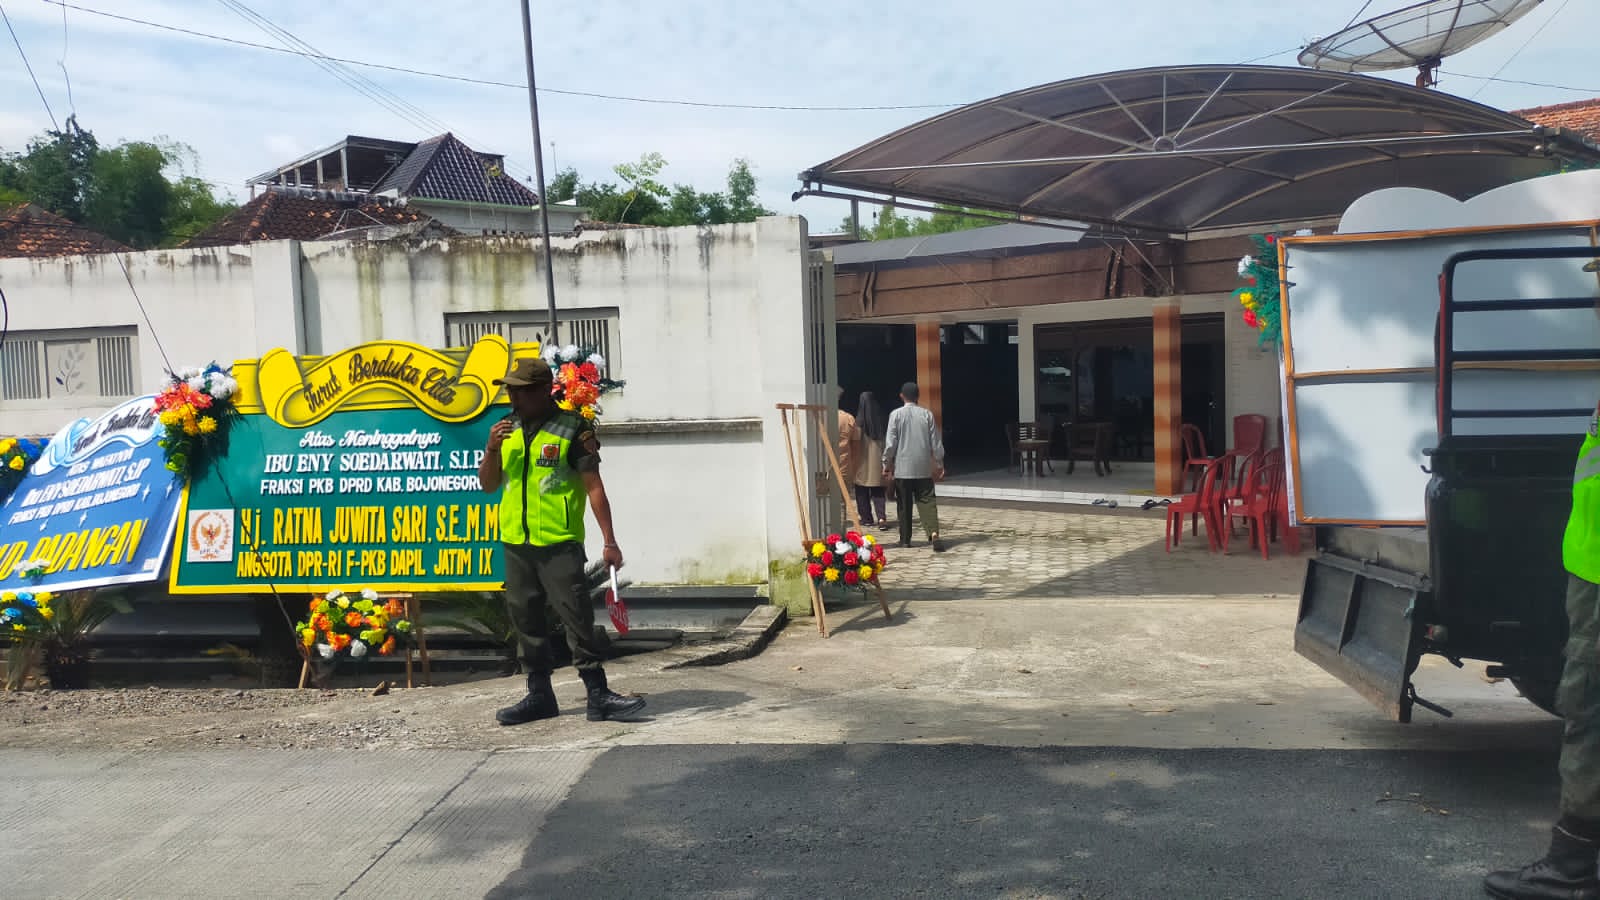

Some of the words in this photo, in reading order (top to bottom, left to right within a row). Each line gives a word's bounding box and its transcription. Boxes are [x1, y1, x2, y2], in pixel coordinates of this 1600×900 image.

[303, 366, 342, 413] Turut
[349, 348, 420, 386] Berduka
[299, 430, 336, 448] Atas
[339, 428, 441, 450] Meninggalnya
[264, 453, 294, 473] IBU
[296, 453, 334, 472] ENY
[339, 451, 444, 472] SOEDARWATI,
[260, 478, 304, 495] FRAKSI
[308, 477, 334, 493] PKB
[339, 477, 373, 493] DPRD
[376, 476, 404, 492] KAB.
[240, 508, 266, 550] Hj.
[273, 507, 323, 545] RATNA
[329, 506, 386, 543] JUWITA
[237, 551, 293, 577] ANGGOTA
[297, 550, 342, 577] DPR-RI
[346, 549, 387, 577] F-PKB
[390, 548, 426, 576] DAPIL
[433, 548, 472, 576] JATIM
[479, 547, 493, 576] IX
